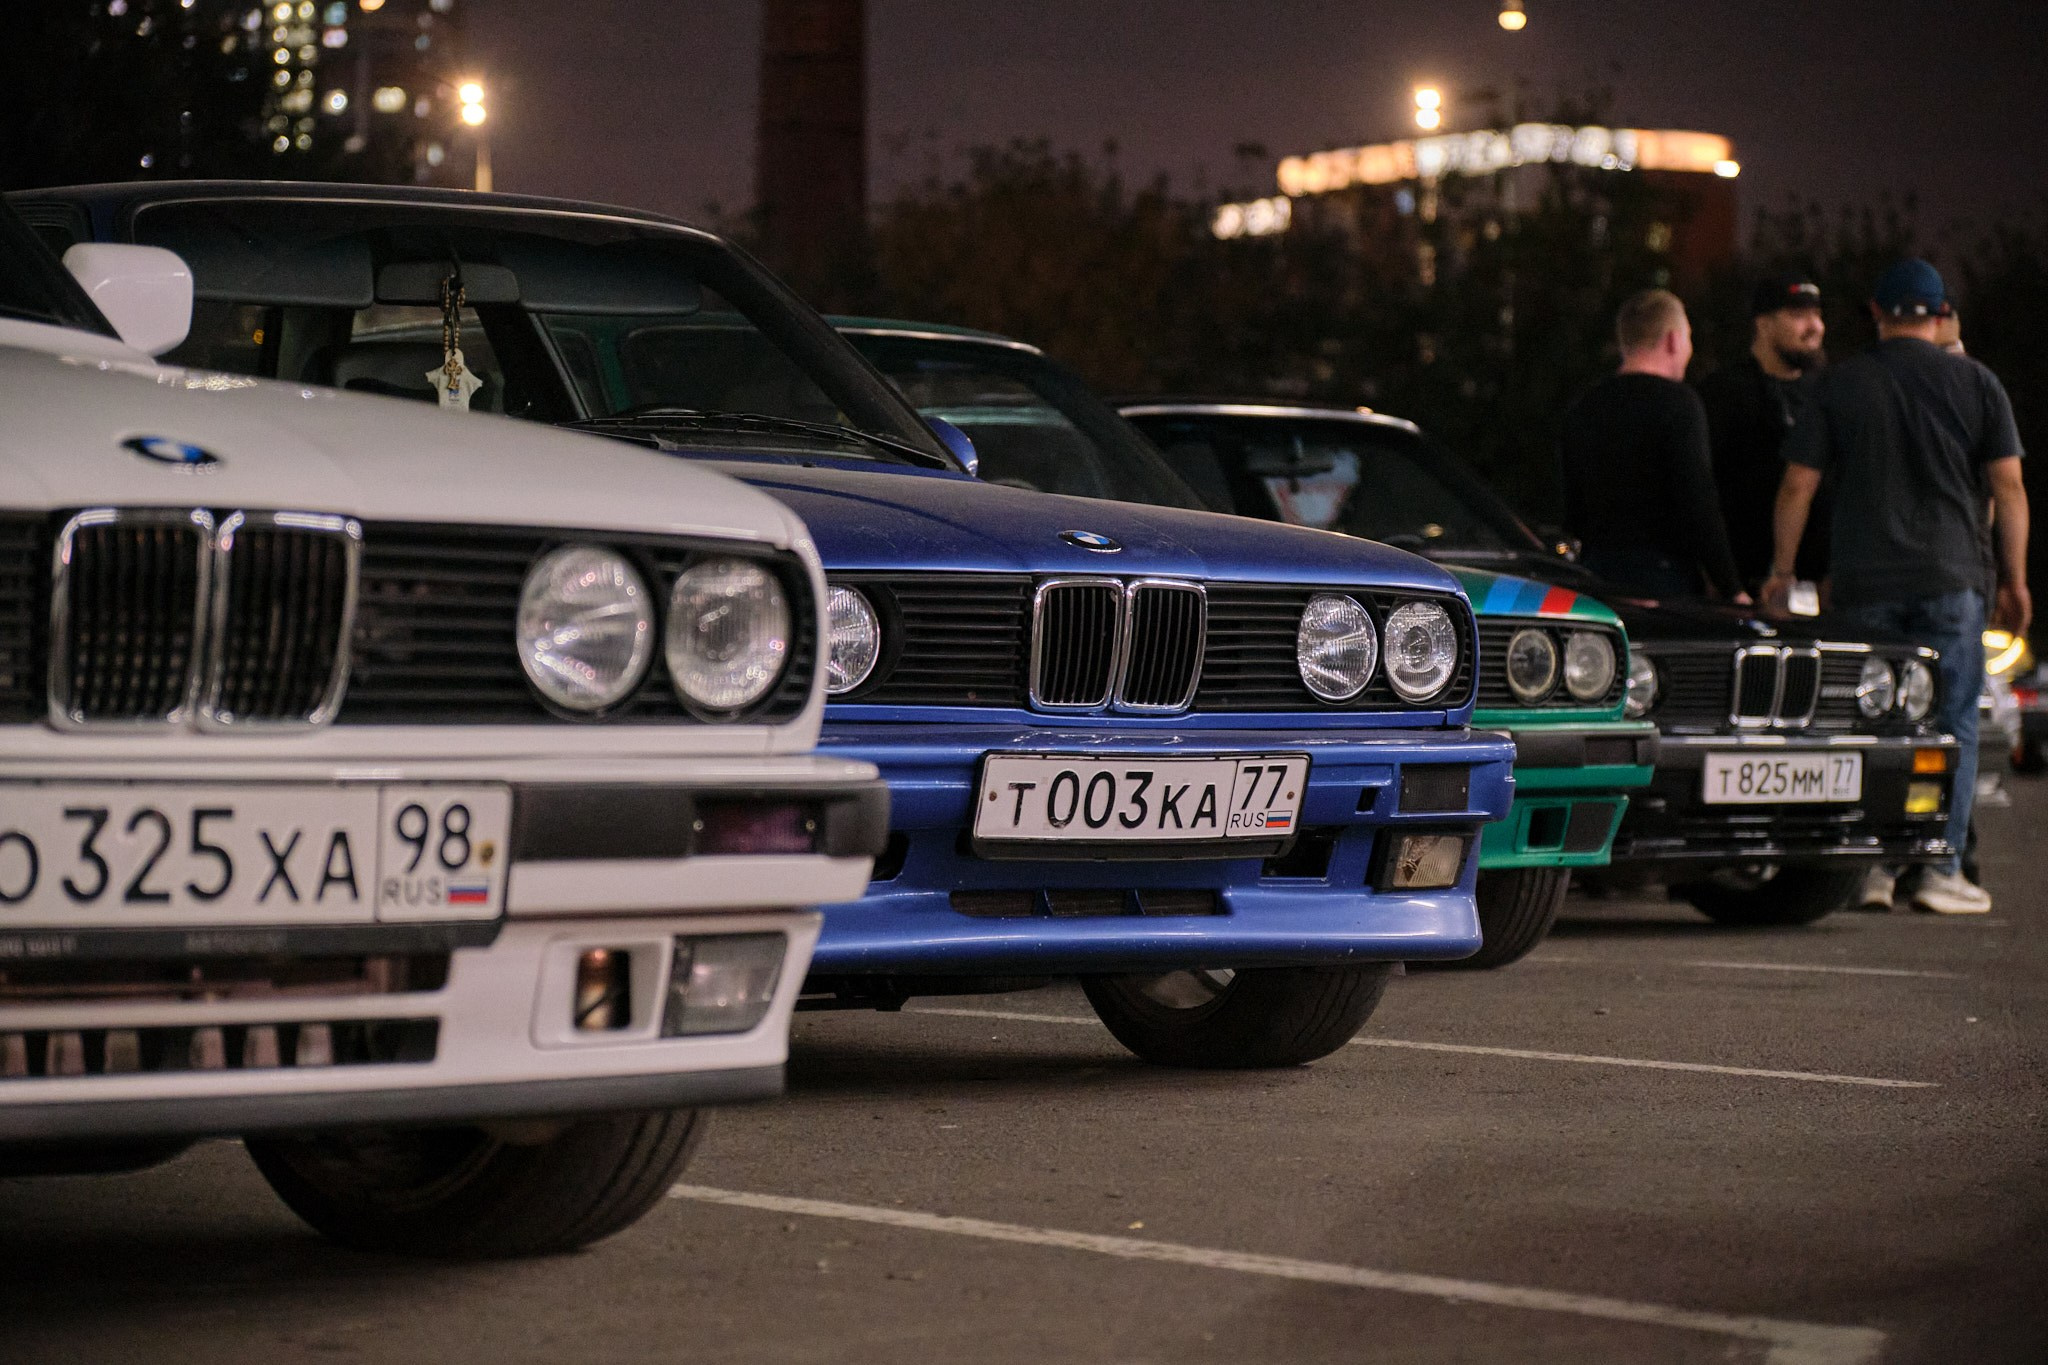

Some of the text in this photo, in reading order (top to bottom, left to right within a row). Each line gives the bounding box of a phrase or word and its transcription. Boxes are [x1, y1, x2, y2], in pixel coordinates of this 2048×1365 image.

[1833, 758, 1855, 783] 77
[1240, 764, 1289, 810] 77
[1230, 812, 1265, 828] RUS
[397, 803, 472, 873] 98
[383, 877, 442, 904] RUS
